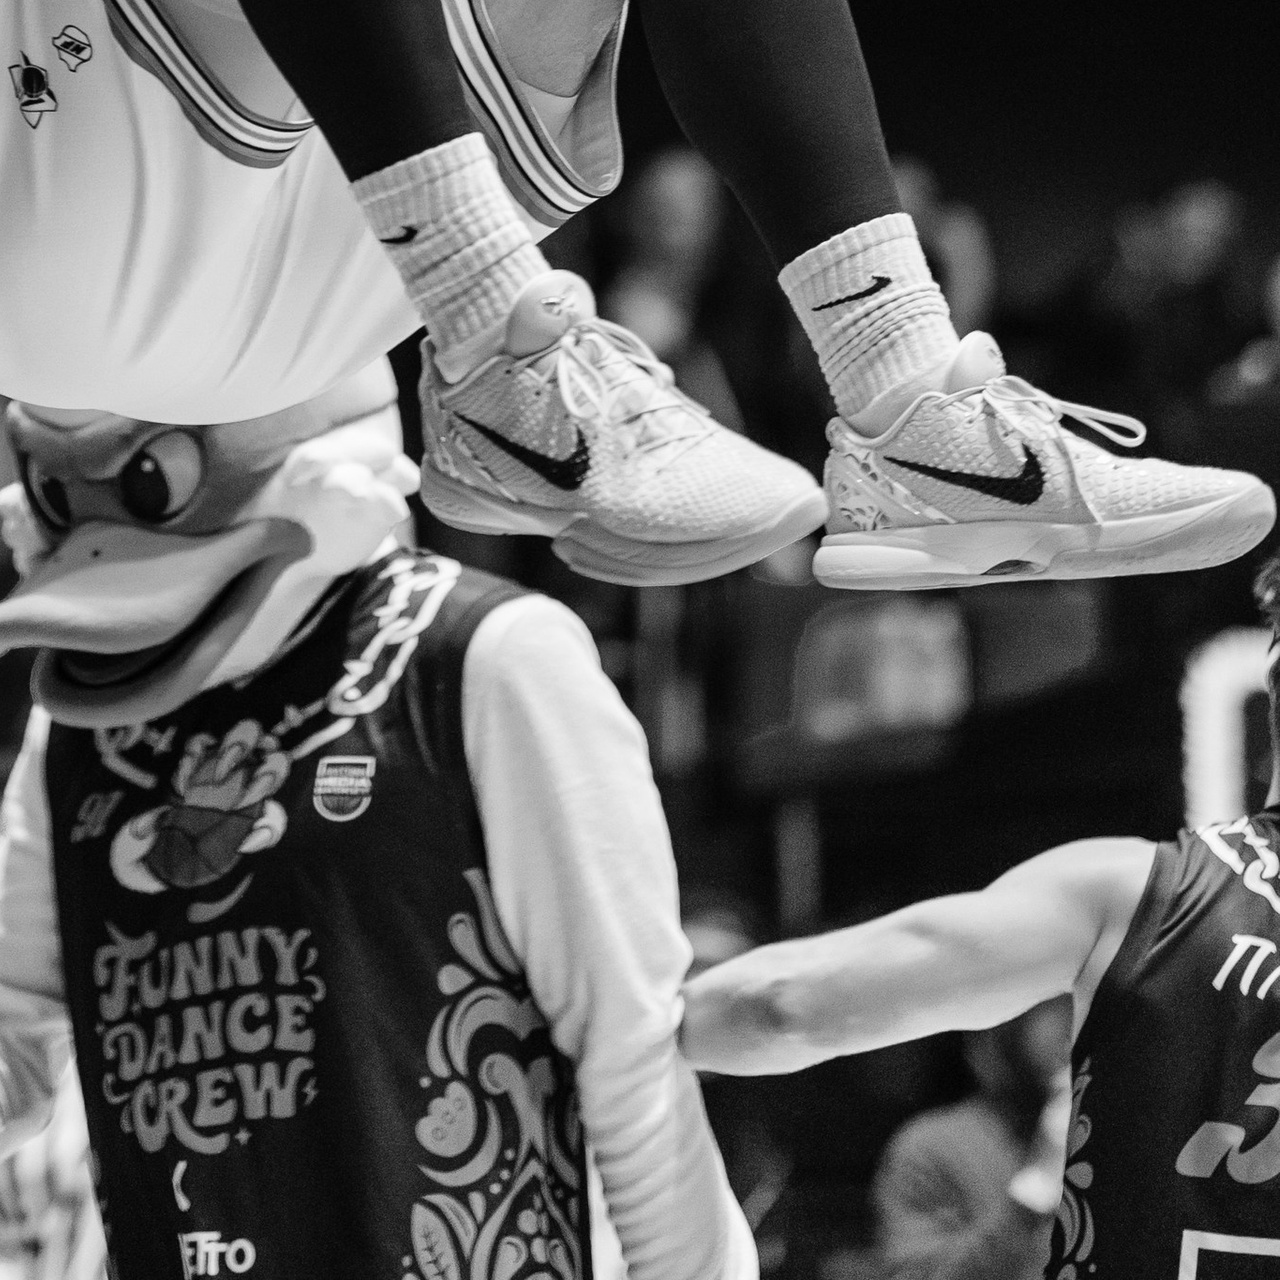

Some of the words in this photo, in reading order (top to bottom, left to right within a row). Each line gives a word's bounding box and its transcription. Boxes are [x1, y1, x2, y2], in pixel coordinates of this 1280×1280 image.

[92, 920, 313, 1022] FUNNY
[102, 993, 316, 1081] DANCE
[129, 1056, 315, 1155] CREW
